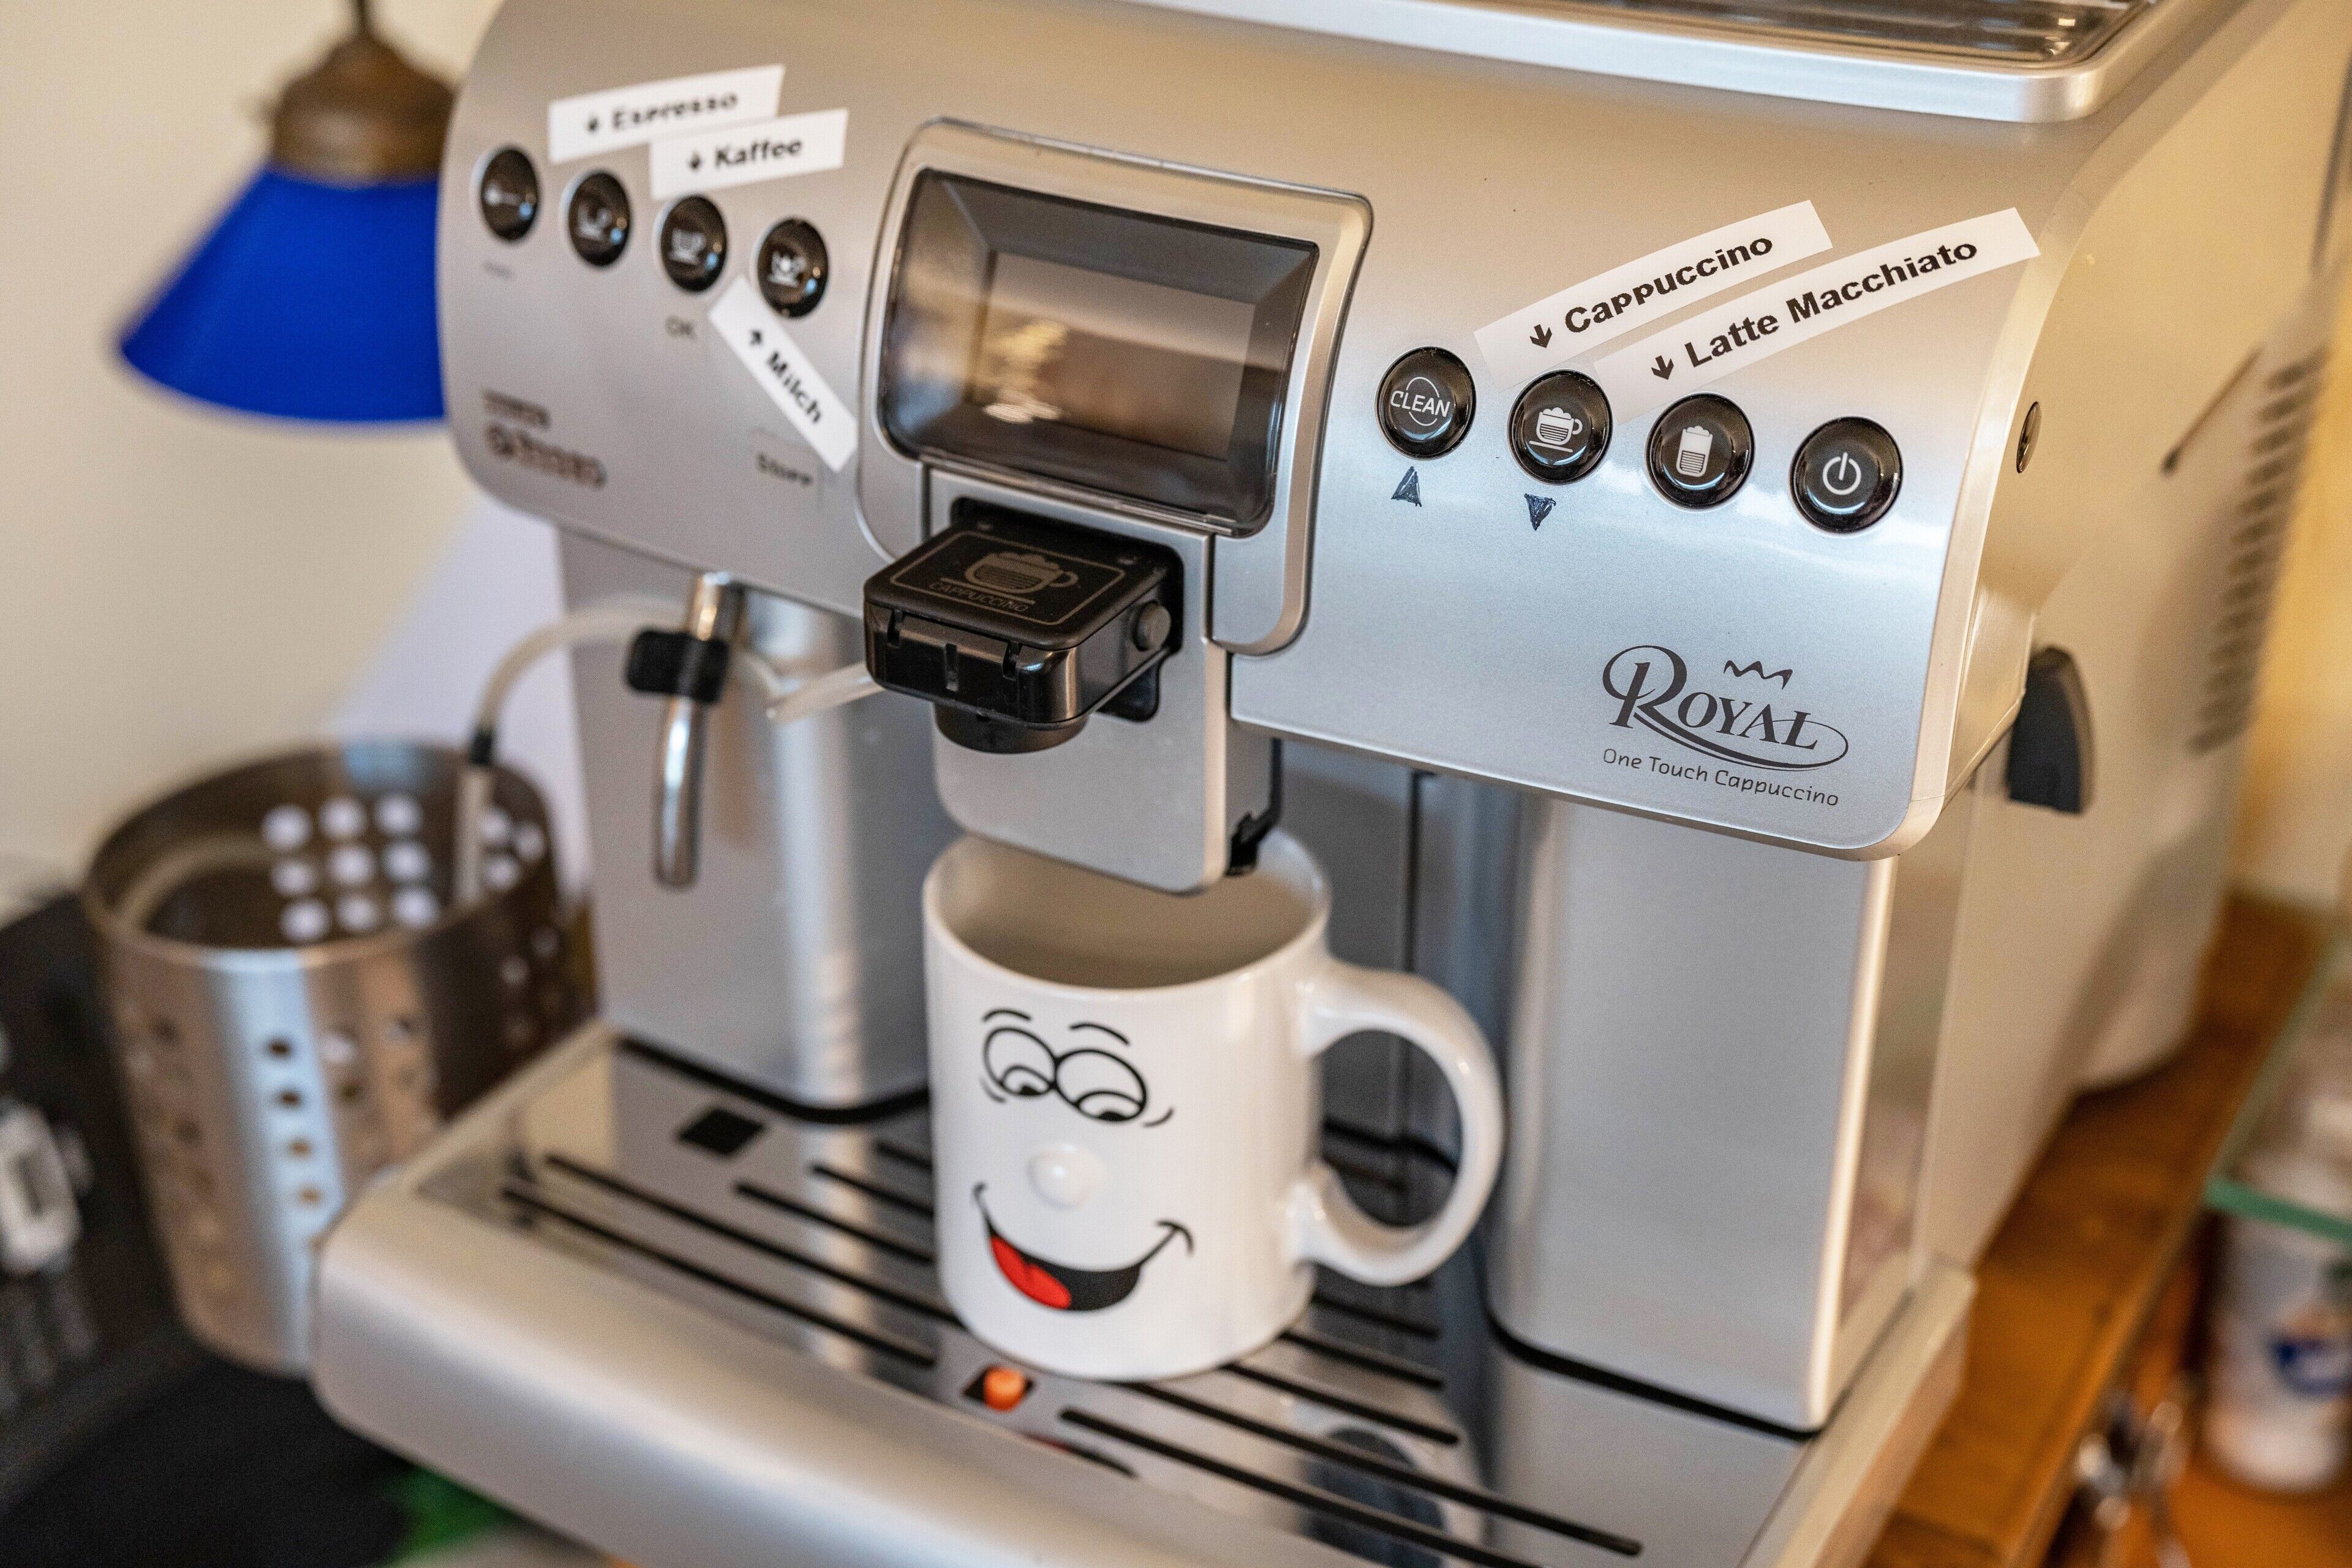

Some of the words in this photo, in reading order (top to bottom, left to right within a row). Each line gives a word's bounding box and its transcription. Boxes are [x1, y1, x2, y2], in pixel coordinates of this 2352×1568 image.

[715, 137, 802, 170] Kaffee
[1565, 237, 1773, 333] Cappuccino
[1684, 314, 1779, 368] Latte
[1785, 243, 1978, 323] Macchiato
[767, 351, 821, 423] Milch
[1390, 390, 1450, 417] CLEAN
[1602, 645, 1849, 771] ROYAL
[1603, 748, 1642, 769] One
[1649, 756, 1708, 782] Touch
[1714, 769, 1839, 806] Cappuccino
